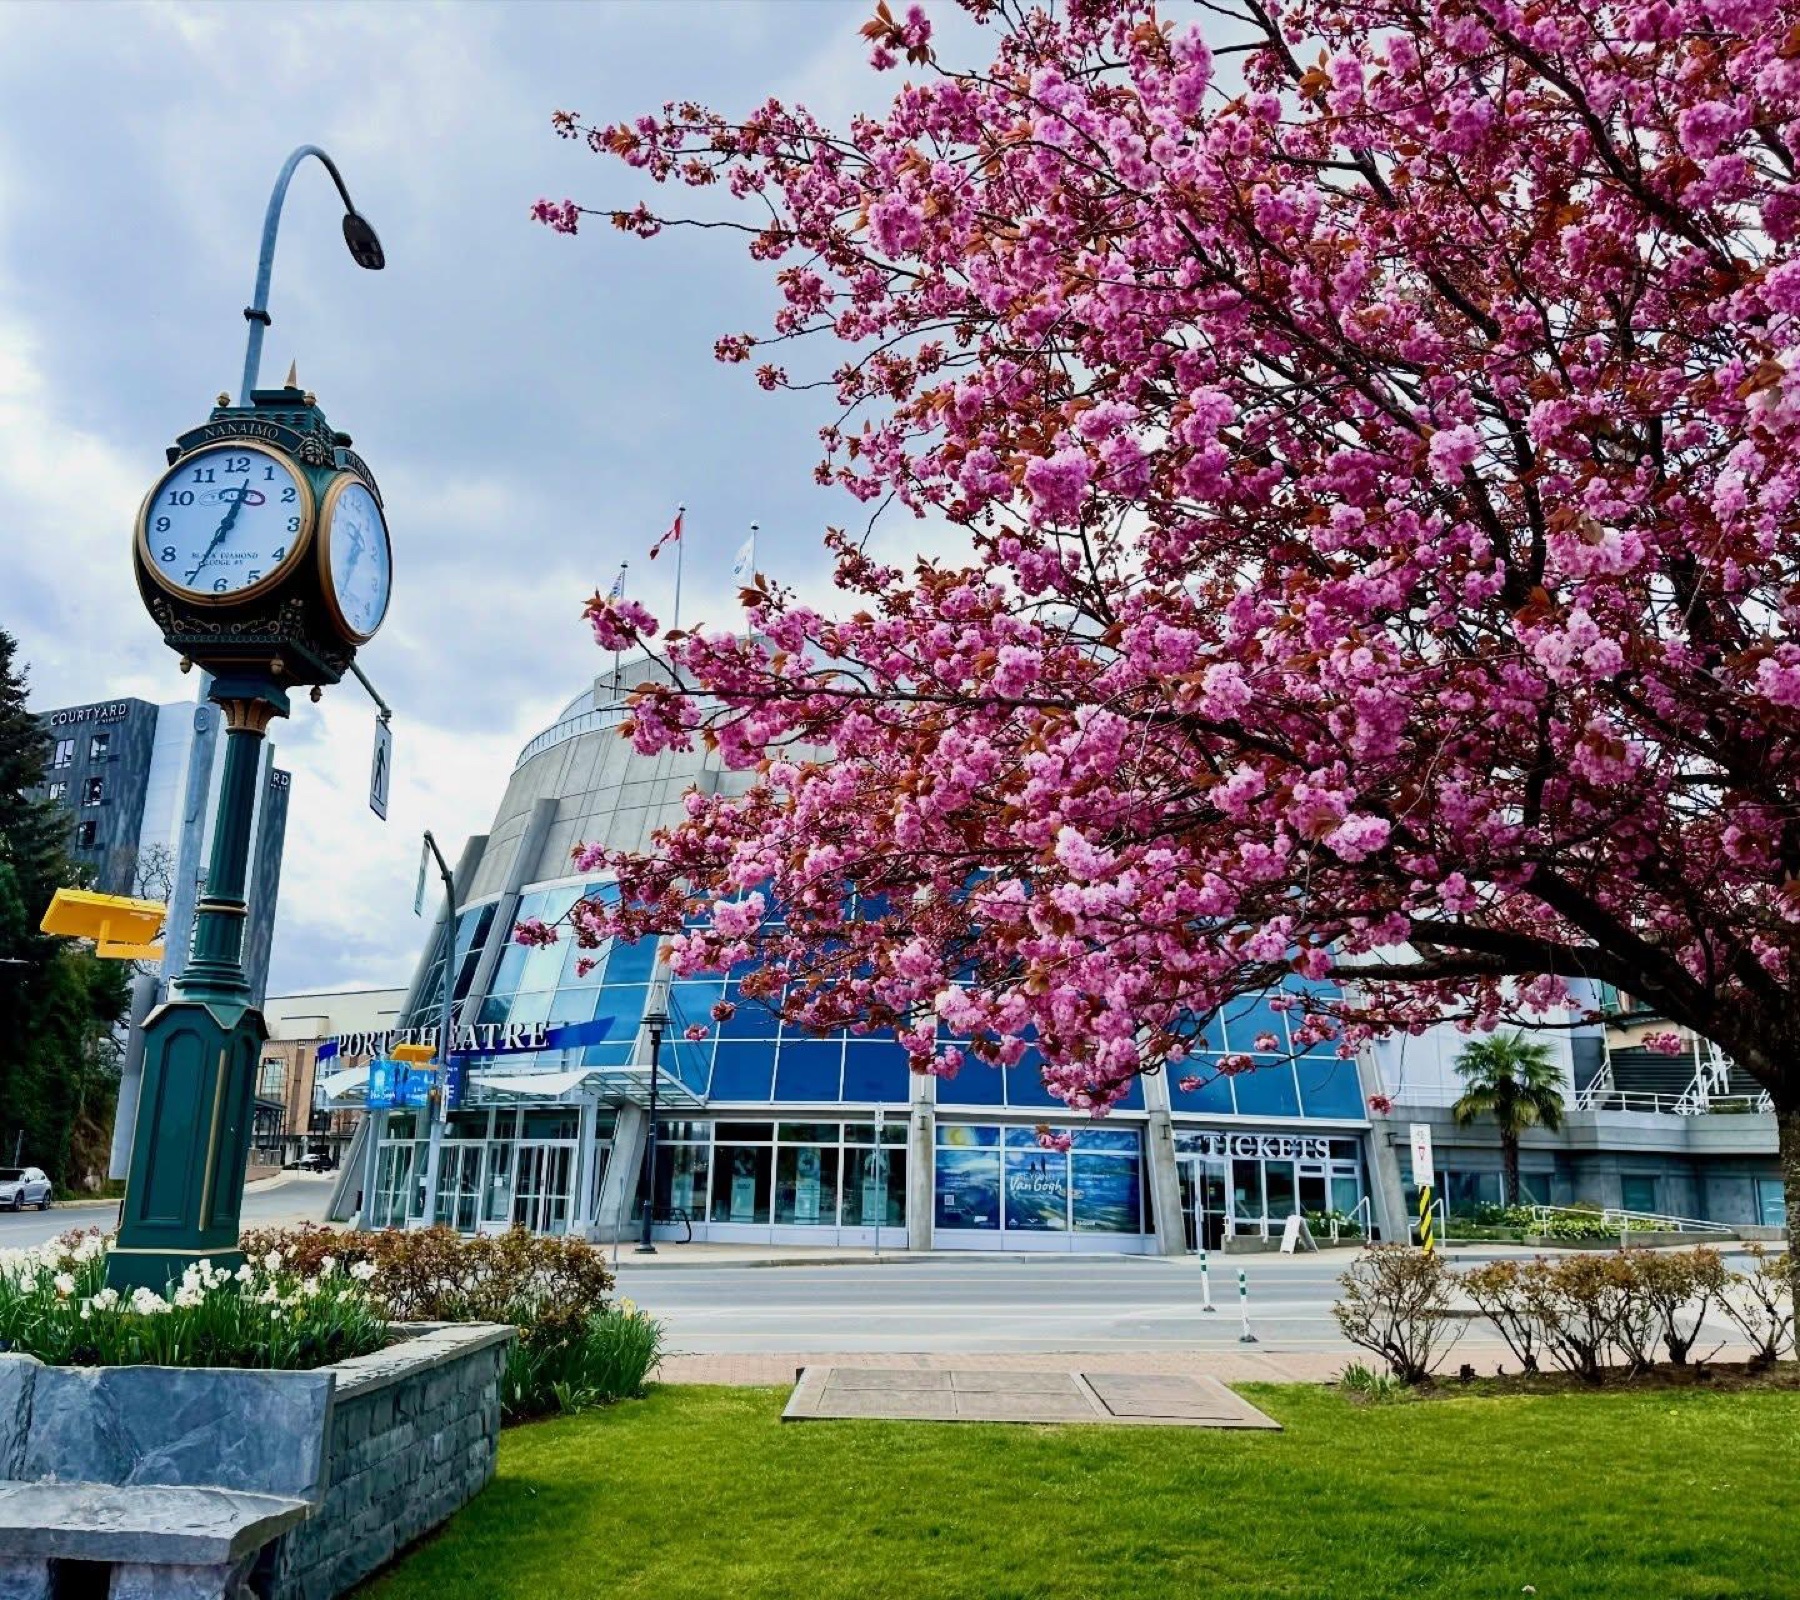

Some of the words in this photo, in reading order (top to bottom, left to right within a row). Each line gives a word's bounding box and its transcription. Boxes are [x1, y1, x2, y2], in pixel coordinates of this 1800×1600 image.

[204, 423, 279, 439] NANAIMO
[225, 457, 250, 473] 12
[264, 465, 274, 480] 1
[192, 468, 215, 483] 11
[168, 490, 195, 506] 10
[281, 487, 296, 502] 2
[156, 517, 171, 532] 9
[287, 517, 300, 532] 3
[161, 546, 176, 562] 8
[271, 546, 286, 562] 4
[184, 570, 199, 586] 7
[213, 578, 228, 592] 6
[247, 570, 261, 585] 5
[50, 703, 126, 726] COURTYARD
[337, 1030, 392, 1058] PORT
[1203, 1134, 1331, 1159] TICKETS
[1010, 1175, 1031, 1191] Van
[1034, 1179, 1062, 1195] Gogh
